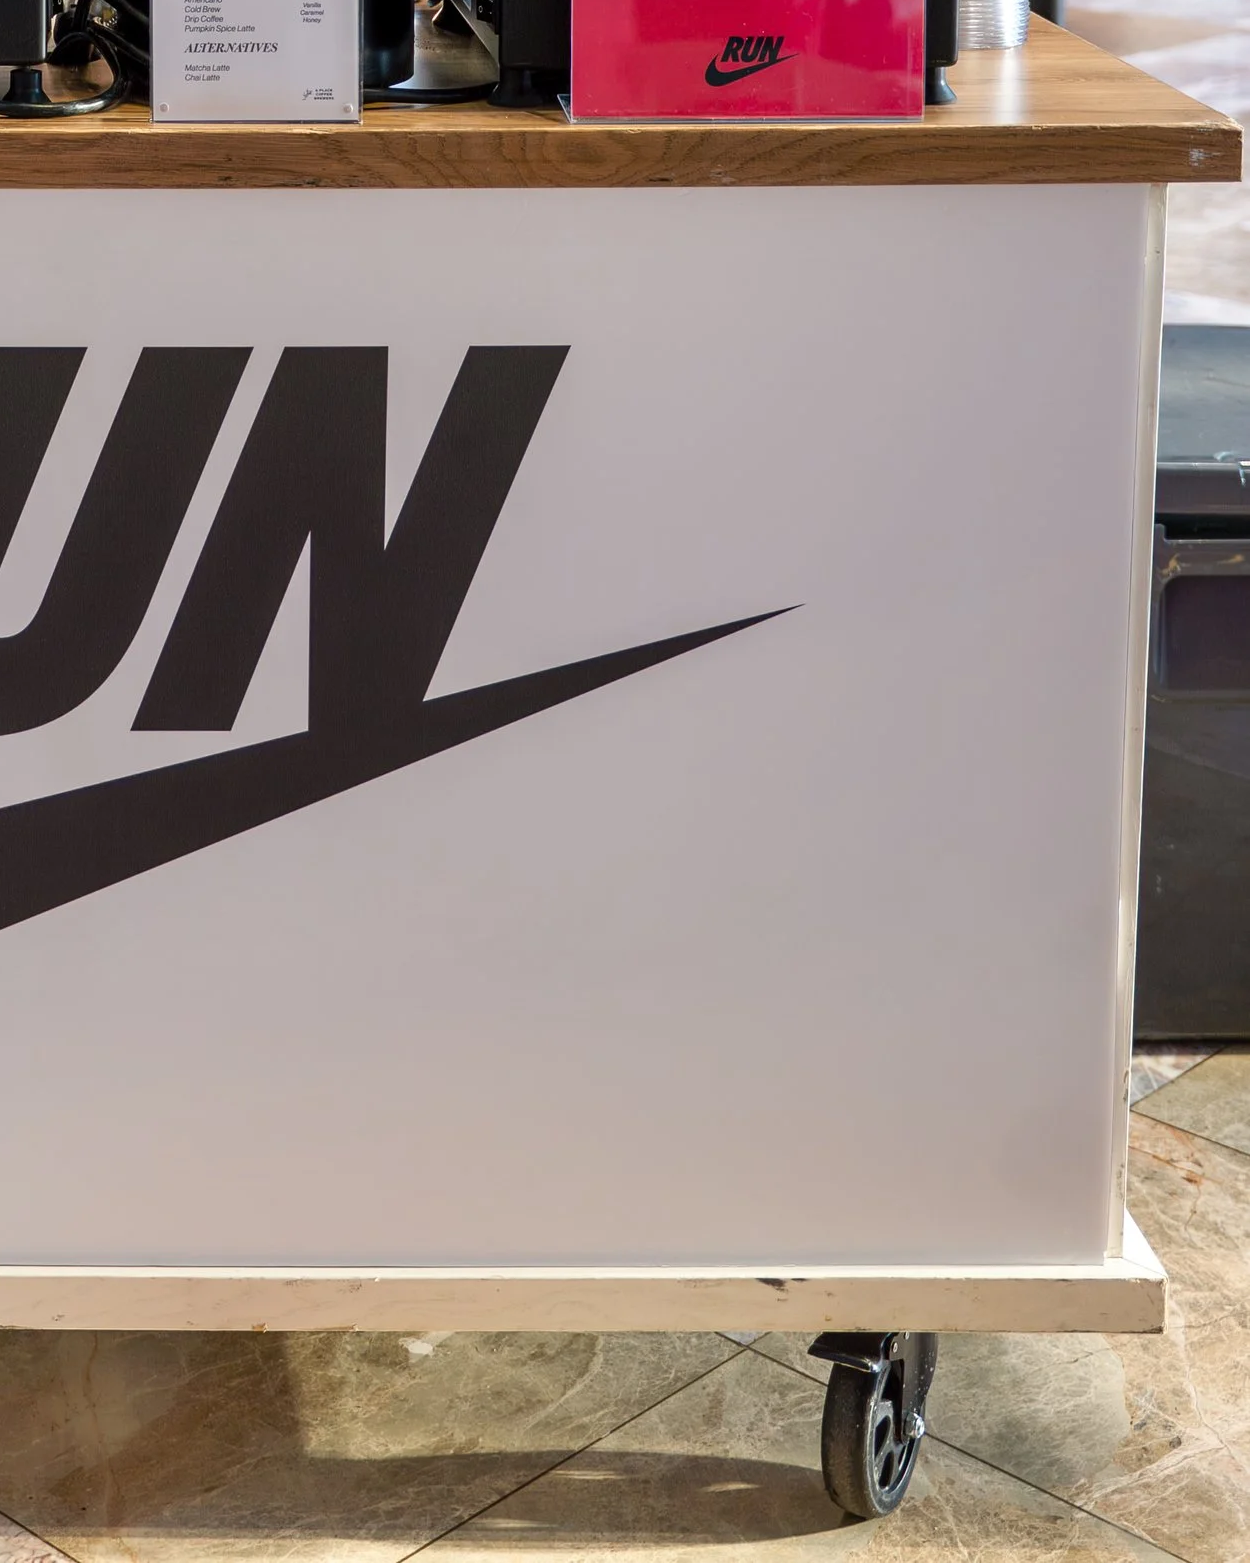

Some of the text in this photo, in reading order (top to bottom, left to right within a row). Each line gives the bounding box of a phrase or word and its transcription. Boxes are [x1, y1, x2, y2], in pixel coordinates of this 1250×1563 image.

[184, 15, 199, 24] Drip
[184, 25, 215, 33] Pumpkin
[216, 25, 236, 33] Spice
[184, 42, 278, 53] ALTERNATIVES
[721, 36, 784, 63] RUN
[184, 64, 230, 72] Matcha Latte
